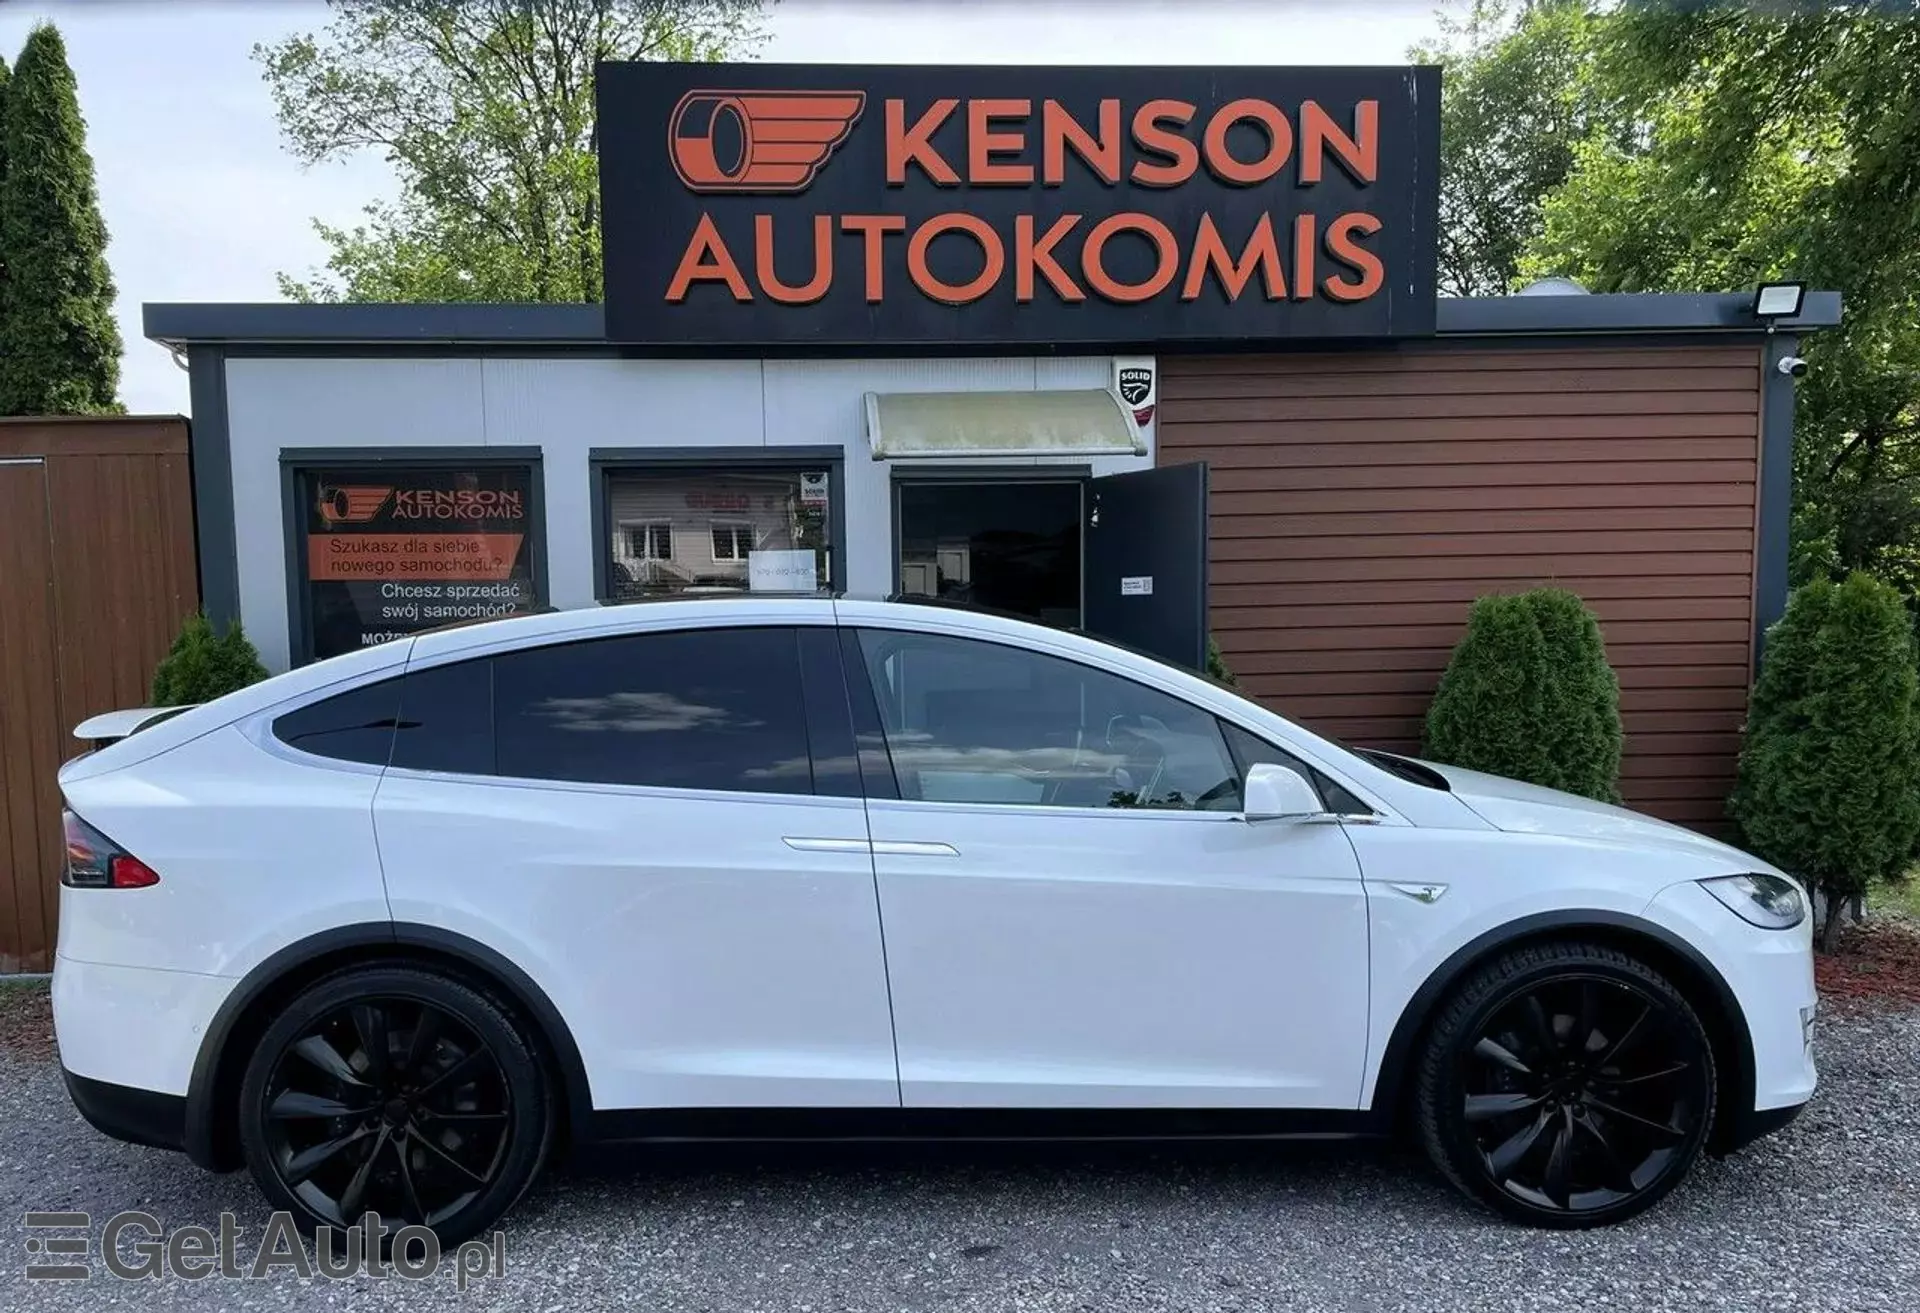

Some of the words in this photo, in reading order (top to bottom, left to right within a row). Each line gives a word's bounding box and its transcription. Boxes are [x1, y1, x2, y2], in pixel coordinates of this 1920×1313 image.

[884, 97, 1380, 187] KENSON
[664, 211, 1384, 303] AUTOKOMIS
[1121, 371, 1151, 381] SOLID
[396, 490, 519, 504] KENSON
[391, 504, 524, 519] AUTOKOMIS
[330, 538, 398, 553] Szukasz
[403, 539, 428, 553] dla
[433, 539, 480, 553] siebie
[330, 560, 394, 575] nowego
[400, 557, 504, 572] samochodu?
[381, 583, 442, 598] Chcesz
[446, 583, 520, 600] sprzedać
[382, 603, 419, 621] swój
[424, 602, 516, 618] samochód?
